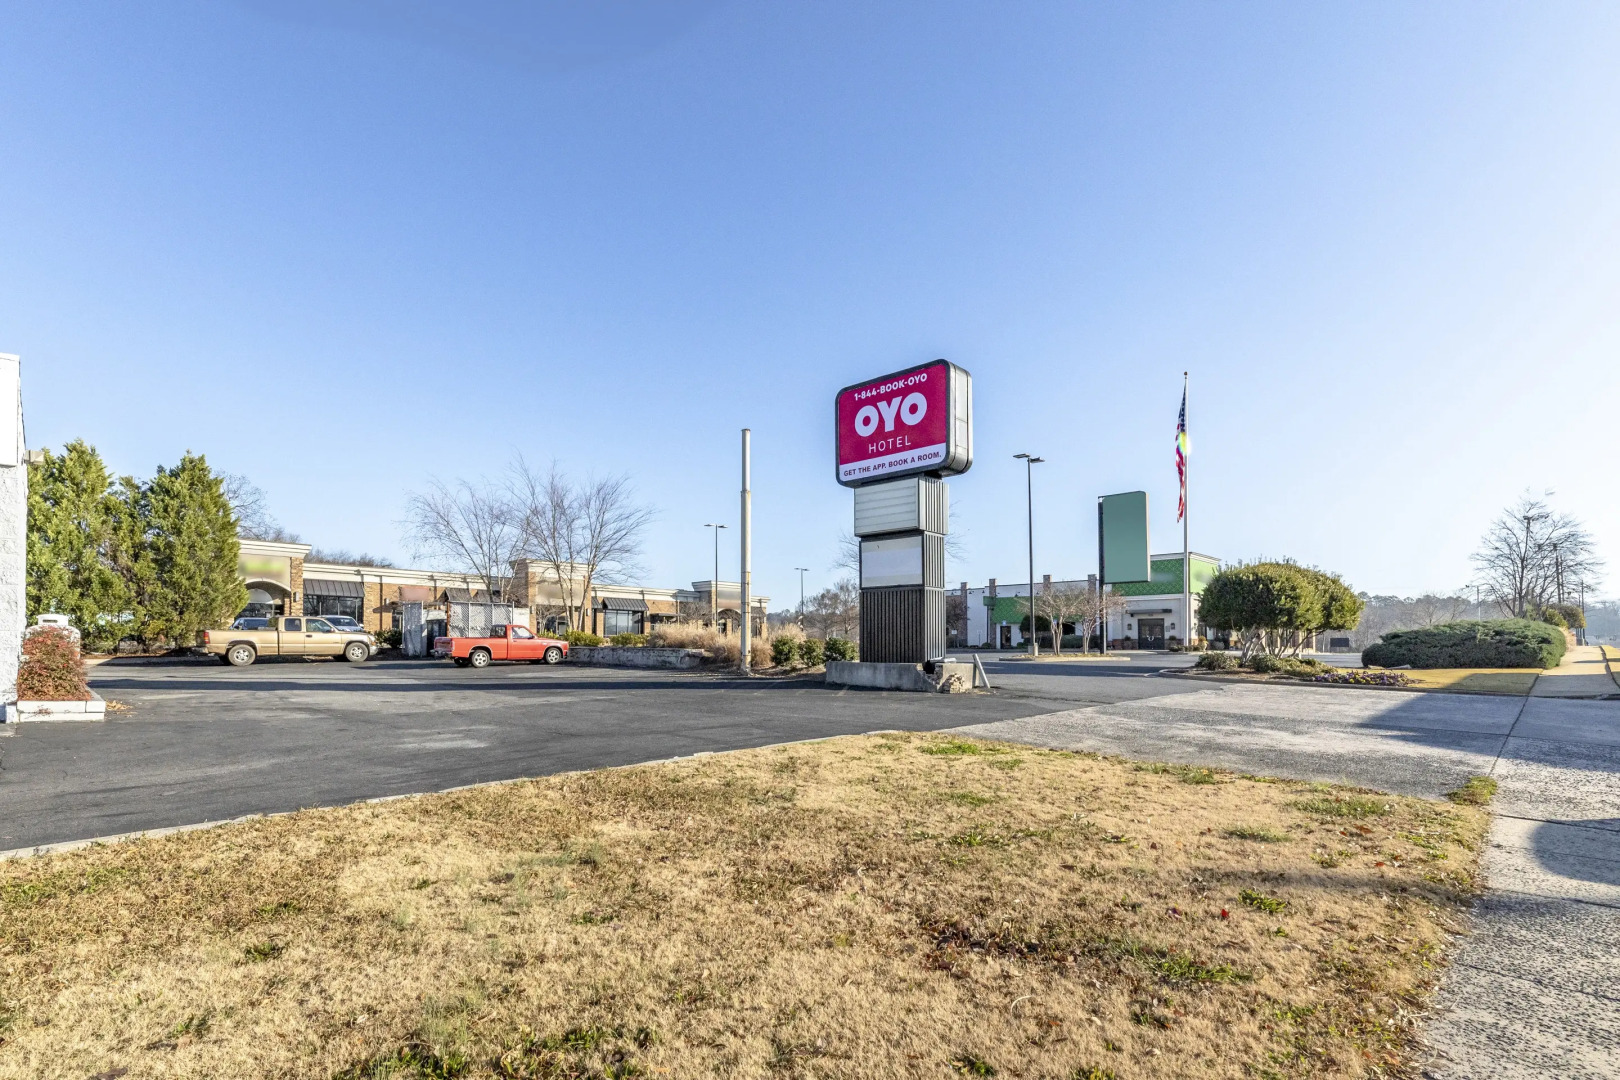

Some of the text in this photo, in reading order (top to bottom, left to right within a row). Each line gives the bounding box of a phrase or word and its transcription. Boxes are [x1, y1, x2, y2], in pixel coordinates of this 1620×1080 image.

[854, 373, 928, 401] 1-844-BOOK-OYO
[854, 392, 928, 437] OYO
[868, 435, 912, 454] HOTEL
[844, 451, 942, 477] GET THE APP. BOOK A ROOM.
